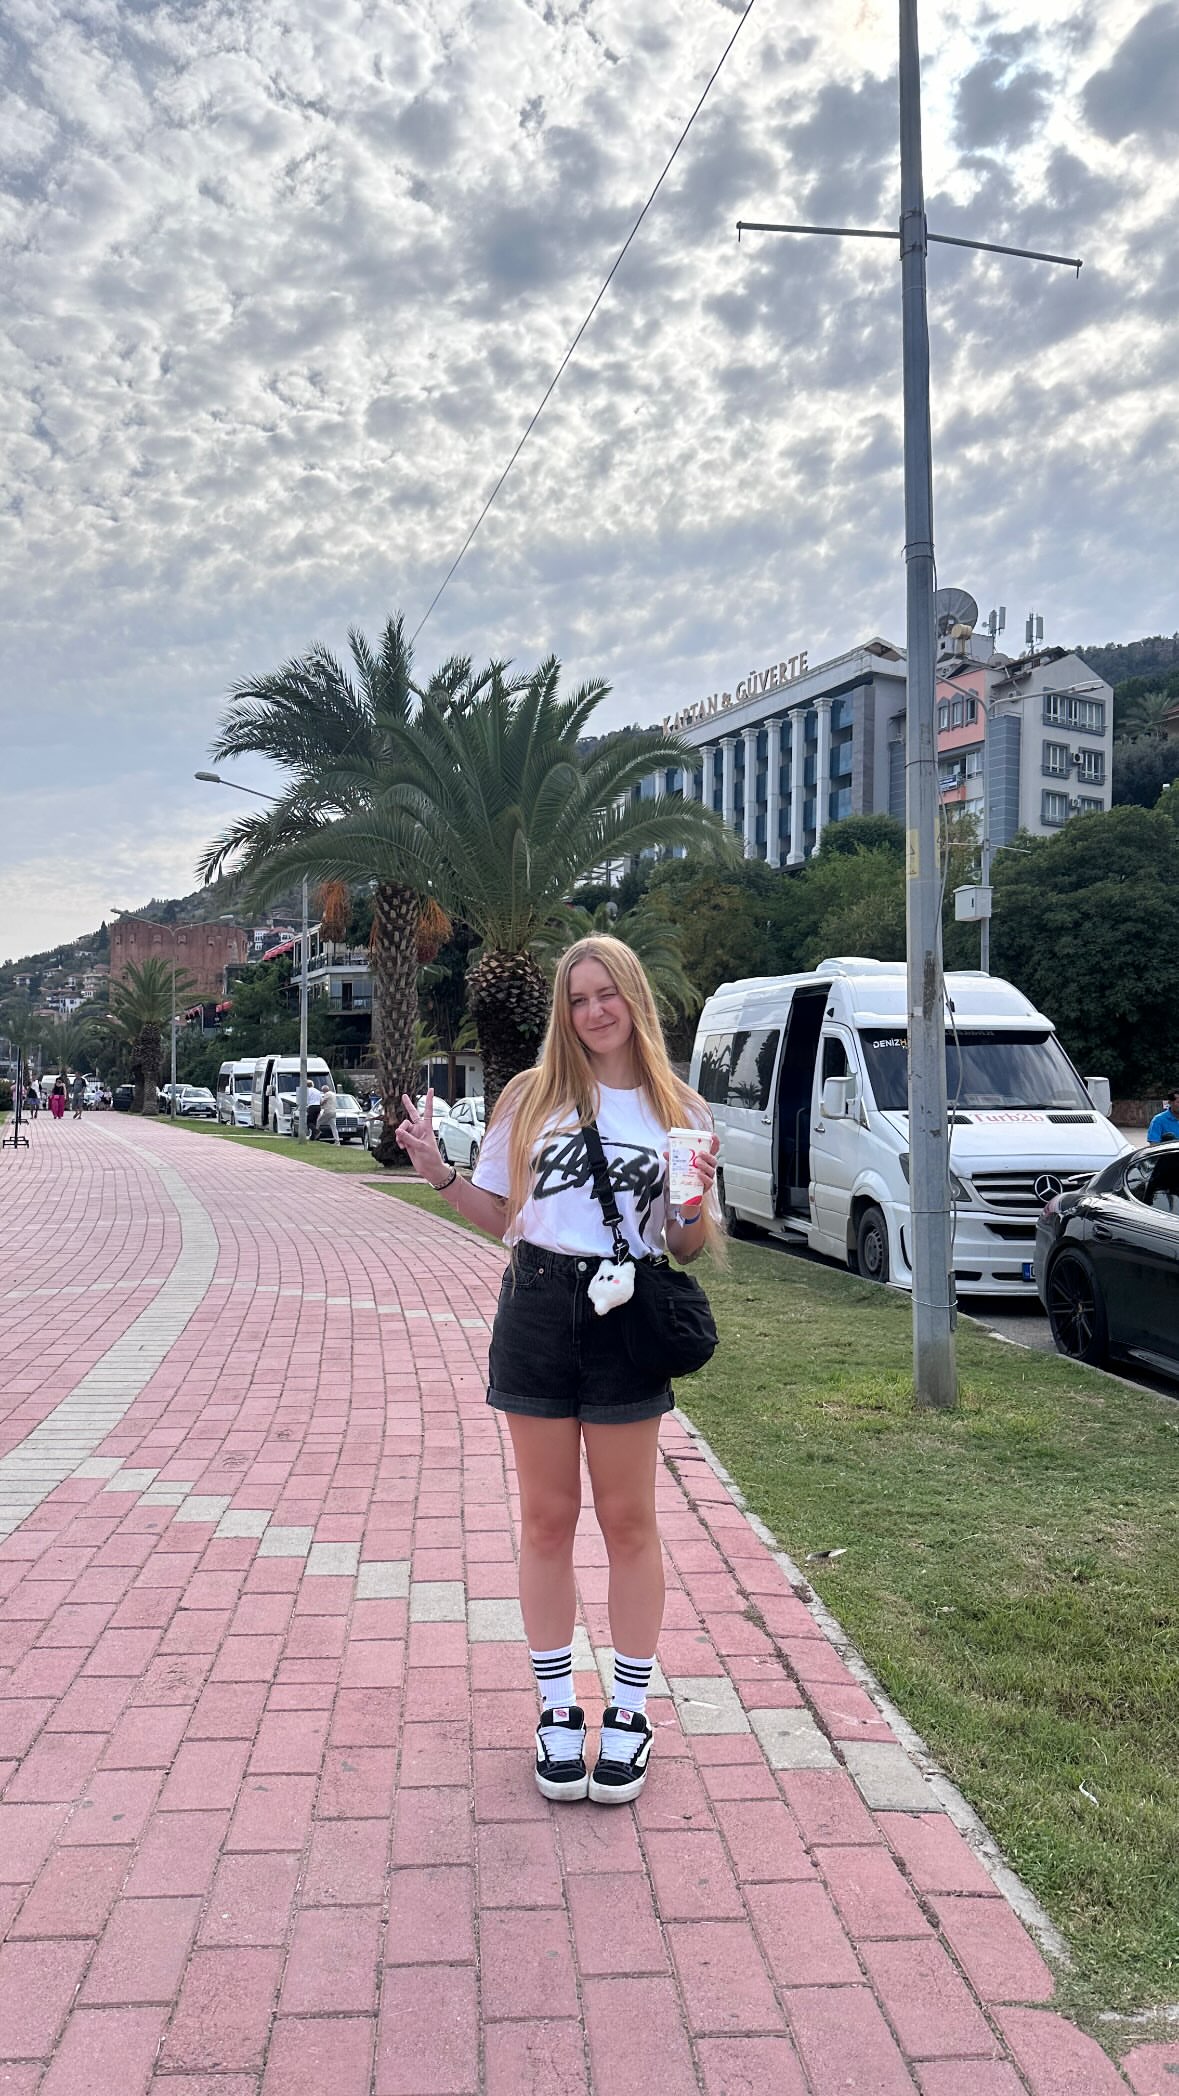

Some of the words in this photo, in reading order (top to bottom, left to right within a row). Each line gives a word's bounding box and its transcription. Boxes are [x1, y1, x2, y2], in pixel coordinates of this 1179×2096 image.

[662, 693, 718, 736] KAPTAN
[721, 692, 734, 708] &
[735, 651, 809, 701] GÜVERTE
[872, 1037, 908, 1049] DENİZH
